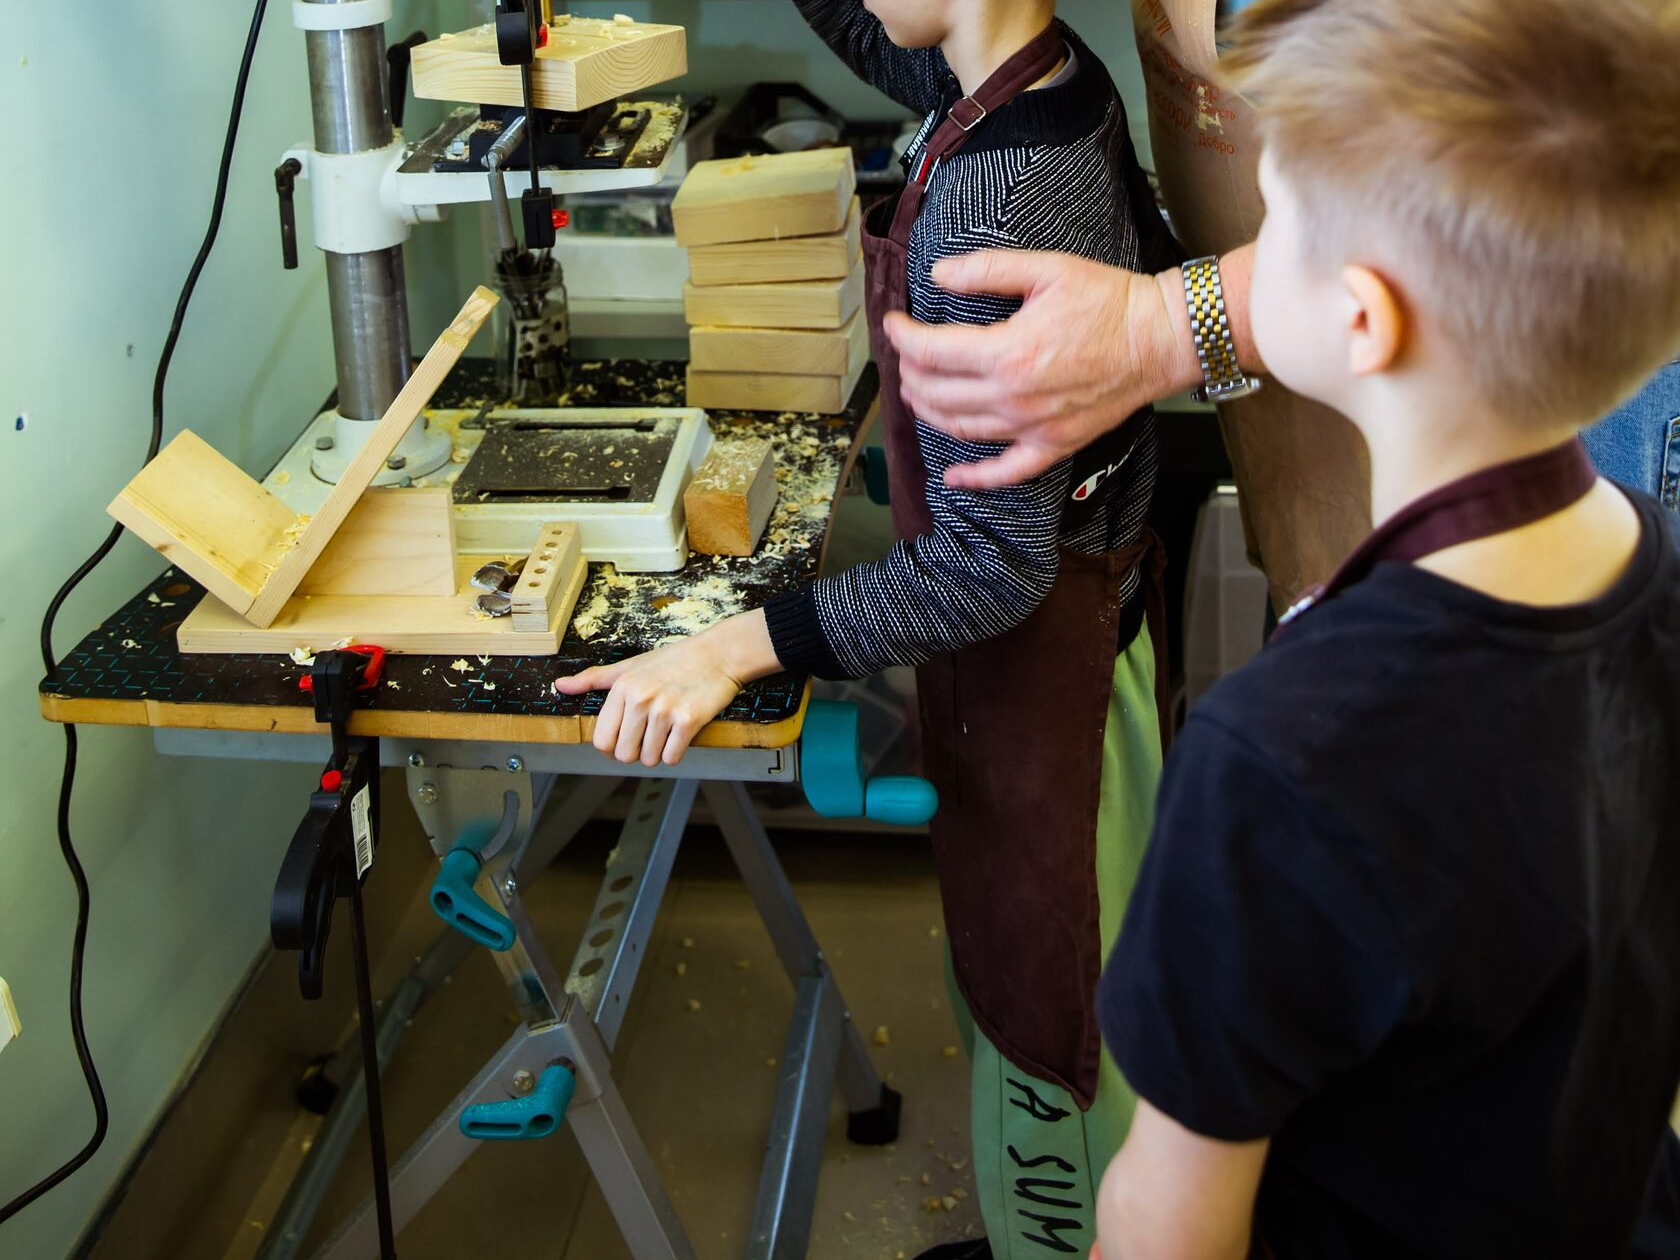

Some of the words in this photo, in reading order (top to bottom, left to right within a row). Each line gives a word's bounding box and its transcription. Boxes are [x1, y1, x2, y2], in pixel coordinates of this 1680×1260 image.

[1198, 133, 1235, 156] Добро
[1006, 1077, 1071, 1122] A
[1007, 1144, 1083, 1253] SUM
